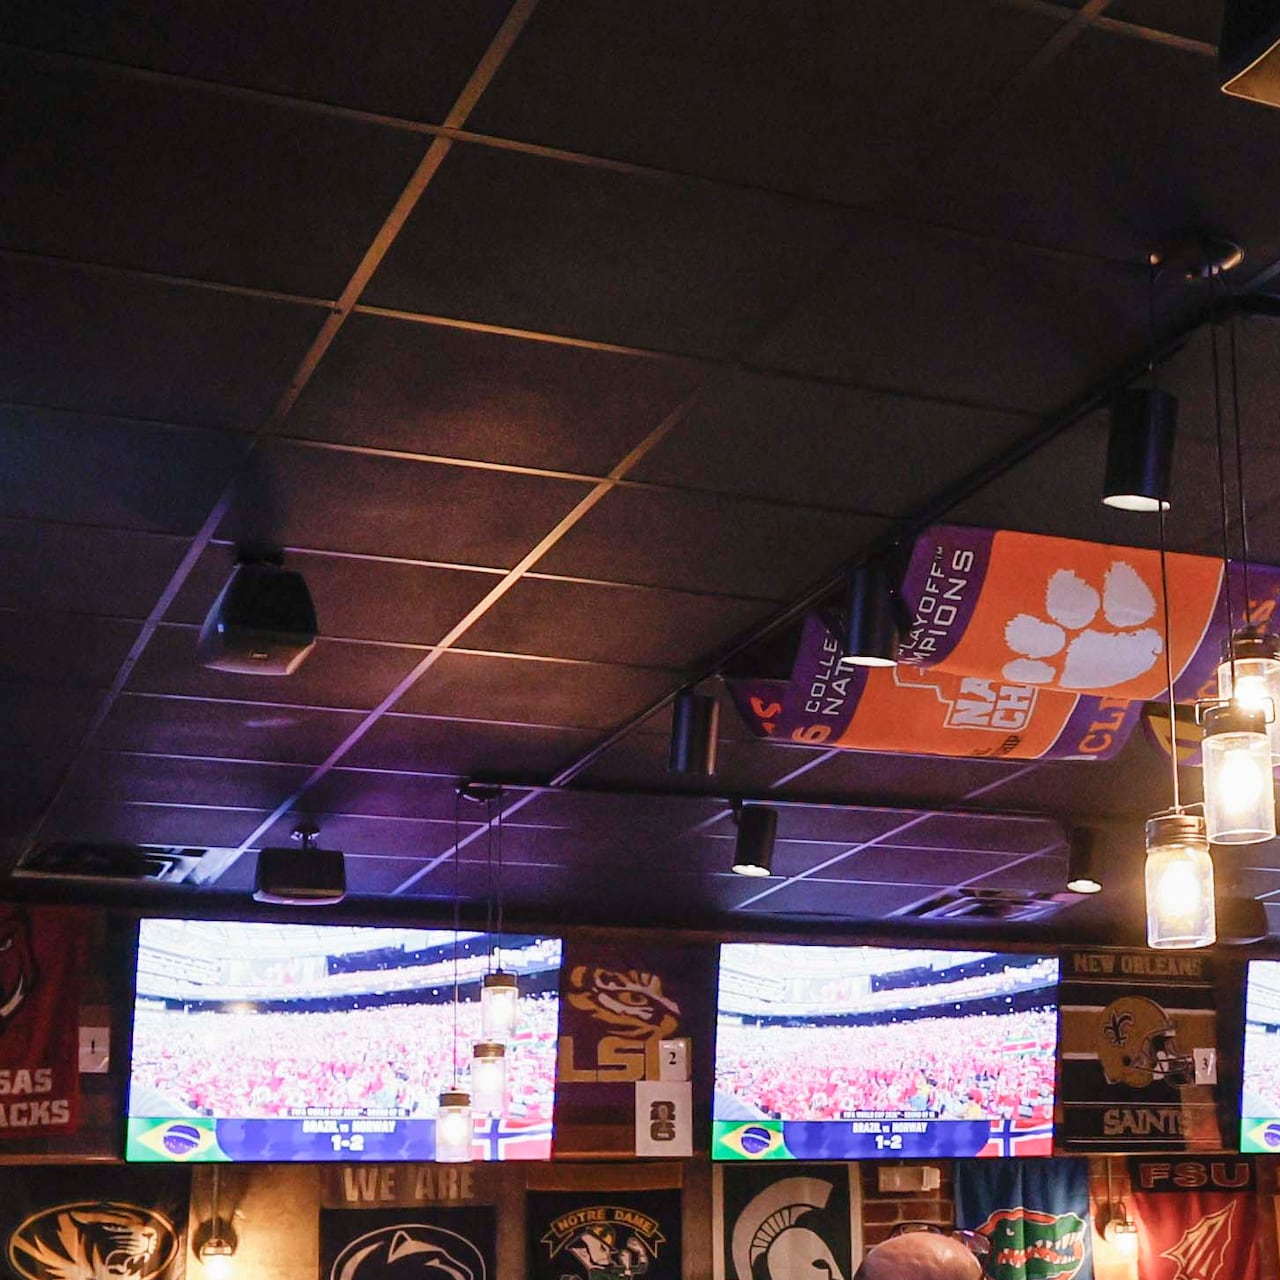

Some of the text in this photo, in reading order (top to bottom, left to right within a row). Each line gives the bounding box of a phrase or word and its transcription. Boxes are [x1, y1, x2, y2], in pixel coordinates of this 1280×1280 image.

[1074, 953, 1201, 977] NEW ORLEANS
[668, 1052, 677, 1065] 2
[302, 1120, 339, 1133] BRAZIL
[351, 1120, 396, 1133] NORWAY
[331, 1134, 364, 1151] 1-2
[875, 1134, 902, 1149] 1-2
[343, 1166, 475, 1201] WE ARE
[1139, 1162, 1250, 1189] FSU
[556, 1208, 655, 1233] NOTRE DAME
